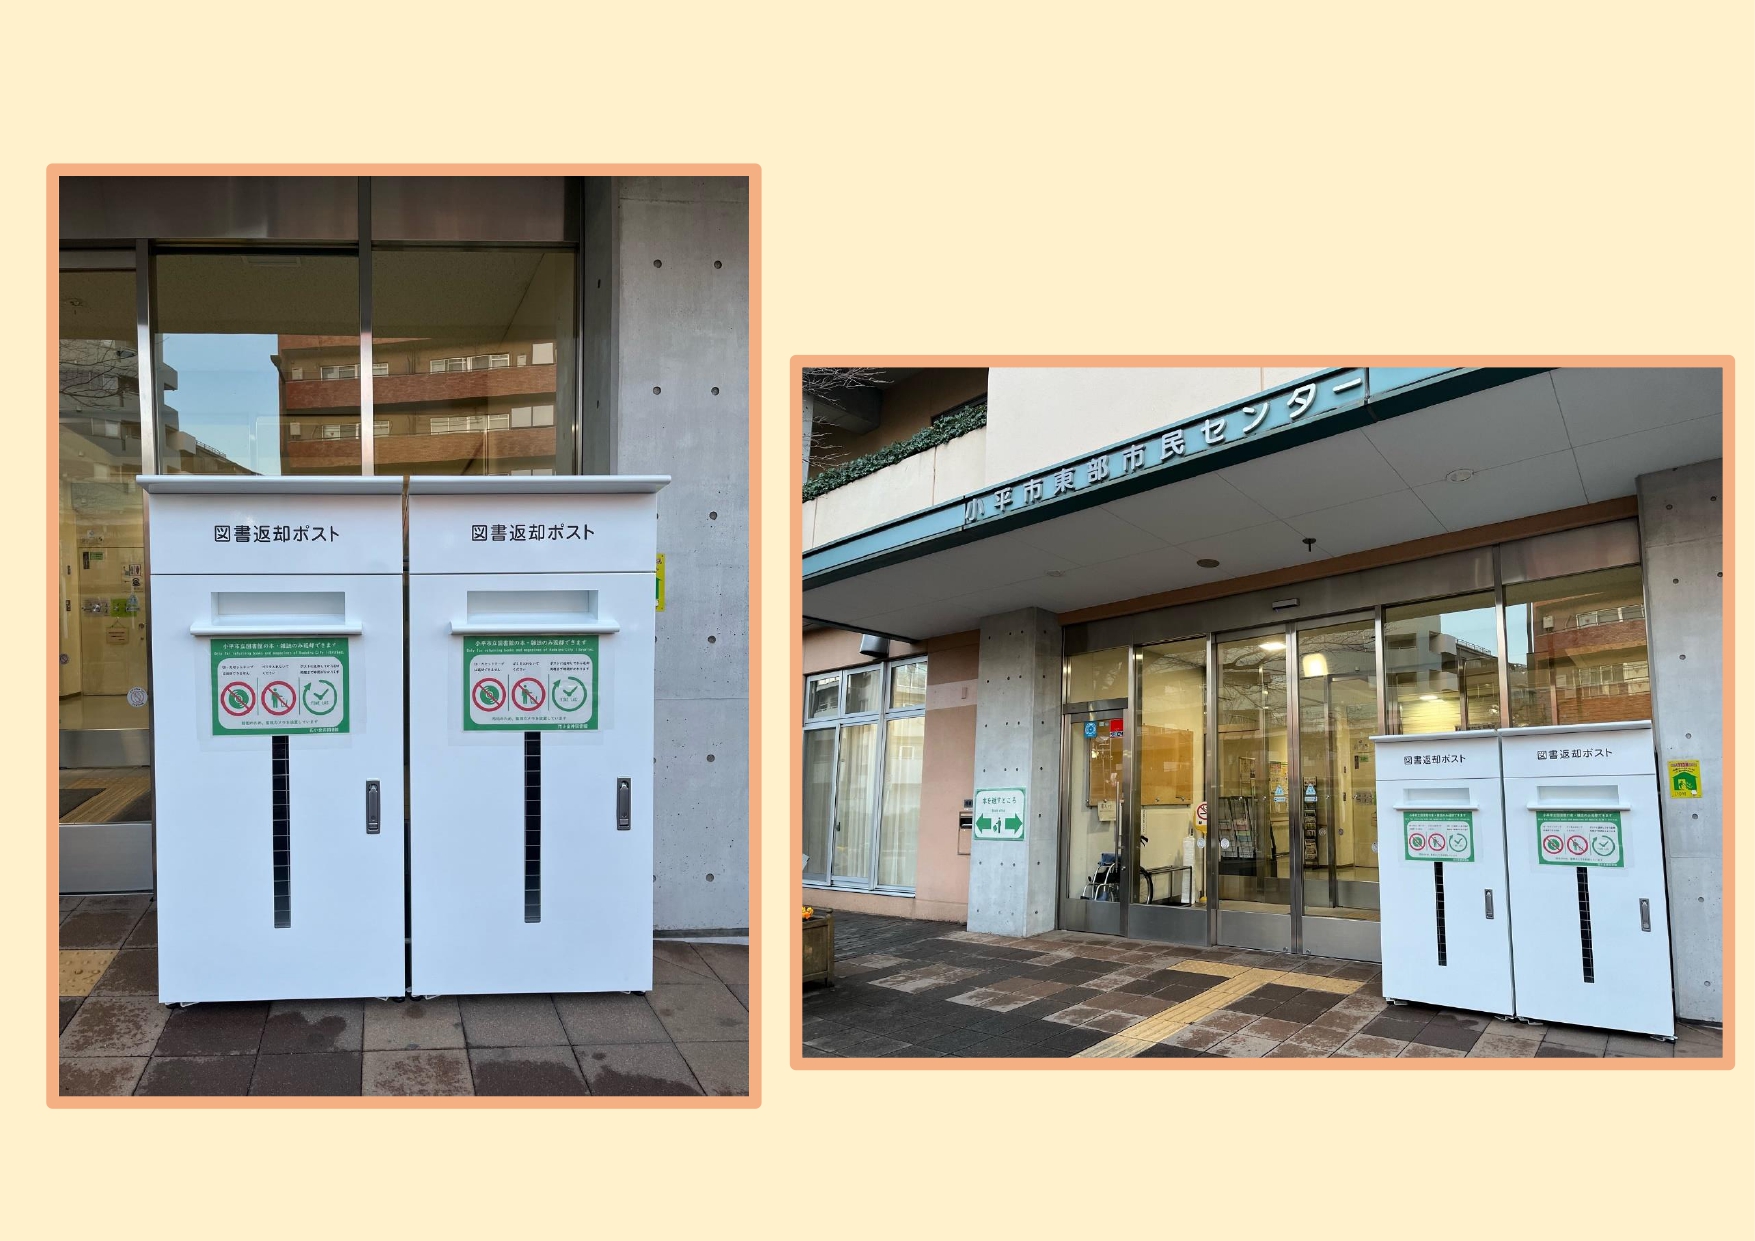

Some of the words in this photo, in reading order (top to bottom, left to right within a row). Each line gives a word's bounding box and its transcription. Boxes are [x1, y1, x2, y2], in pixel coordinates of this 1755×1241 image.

[965, 377, 1363, 524] 小平市東部市民センター
[214, 524, 340, 543] 図書返却ポスト
[471, 523, 595, 542] 図書返却ポスト
[1404, 754, 1466, 766] 図書返却ポスト
[1537, 748, 1613, 760] 図書返却ポスト
